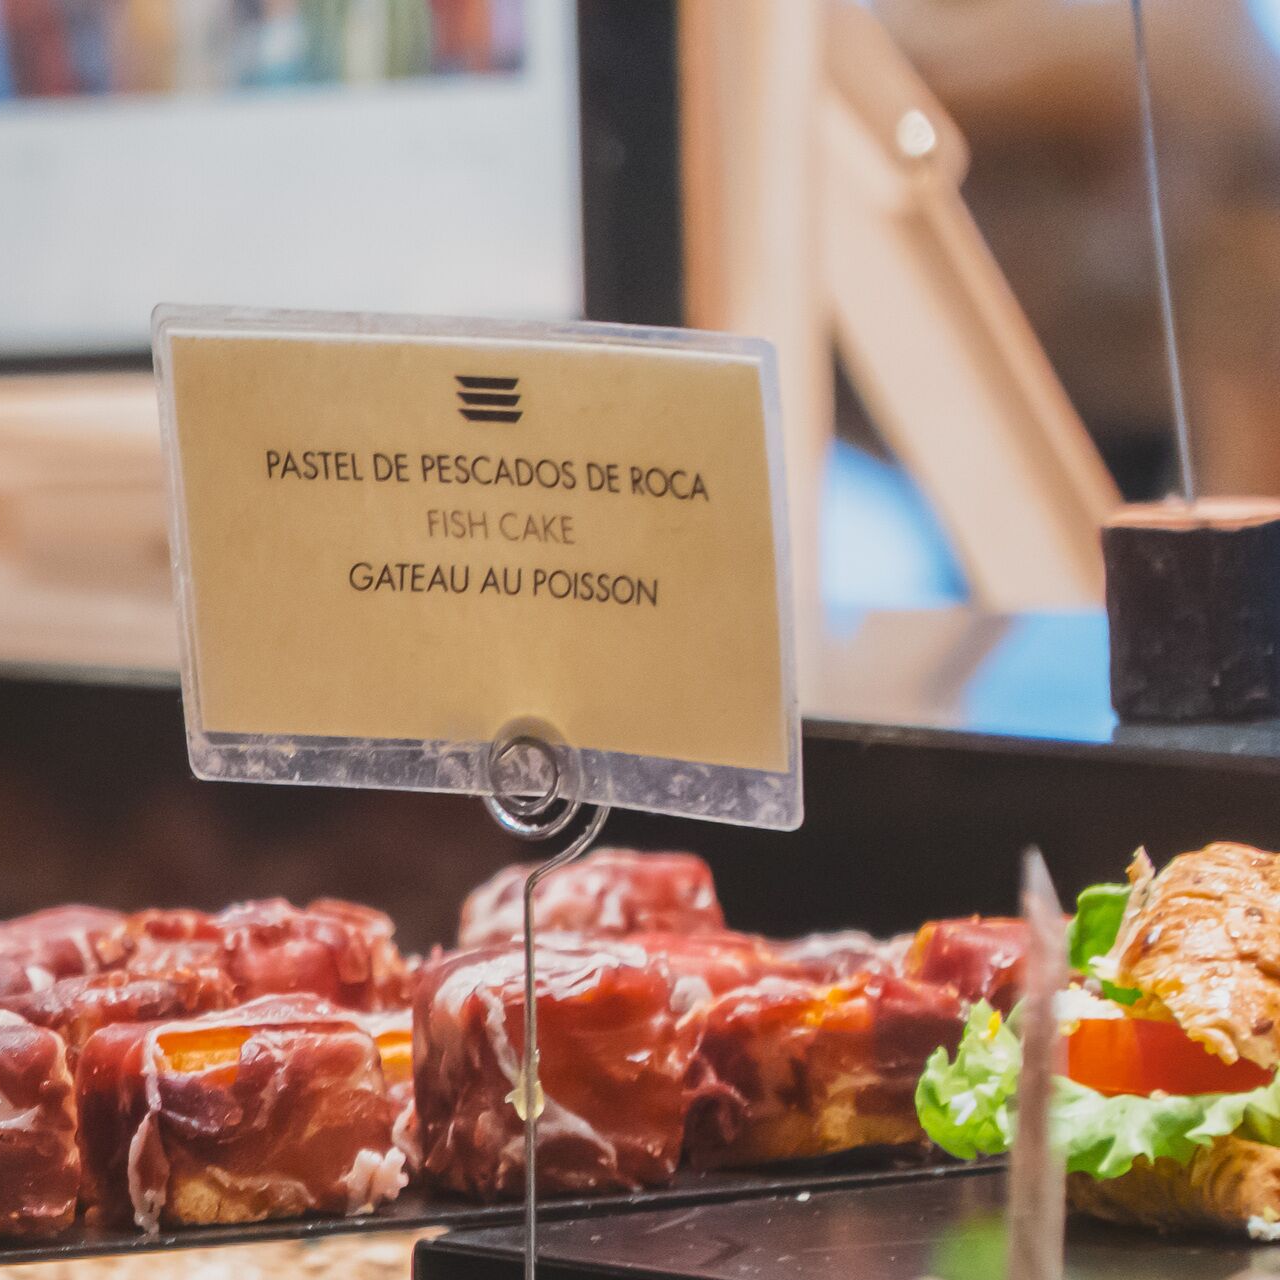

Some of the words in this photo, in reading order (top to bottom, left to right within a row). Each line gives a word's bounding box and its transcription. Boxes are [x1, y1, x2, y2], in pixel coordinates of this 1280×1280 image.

[266, 450, 364, 482] PASTEL
[372, 452, 410, 483] DE
[420, 454, 577, 490] PESCADOS
[586, 462, 621, 494] DE
[629, 466, 710, 502] ROCA
[426, 509, 489, 540] FISH
[498, 512, 576, 545] CAKE
[348, 561, 470, 594] GATEAU
[479, 567, 522, 596] AU
[532, 569, 658, 607] POISSON
